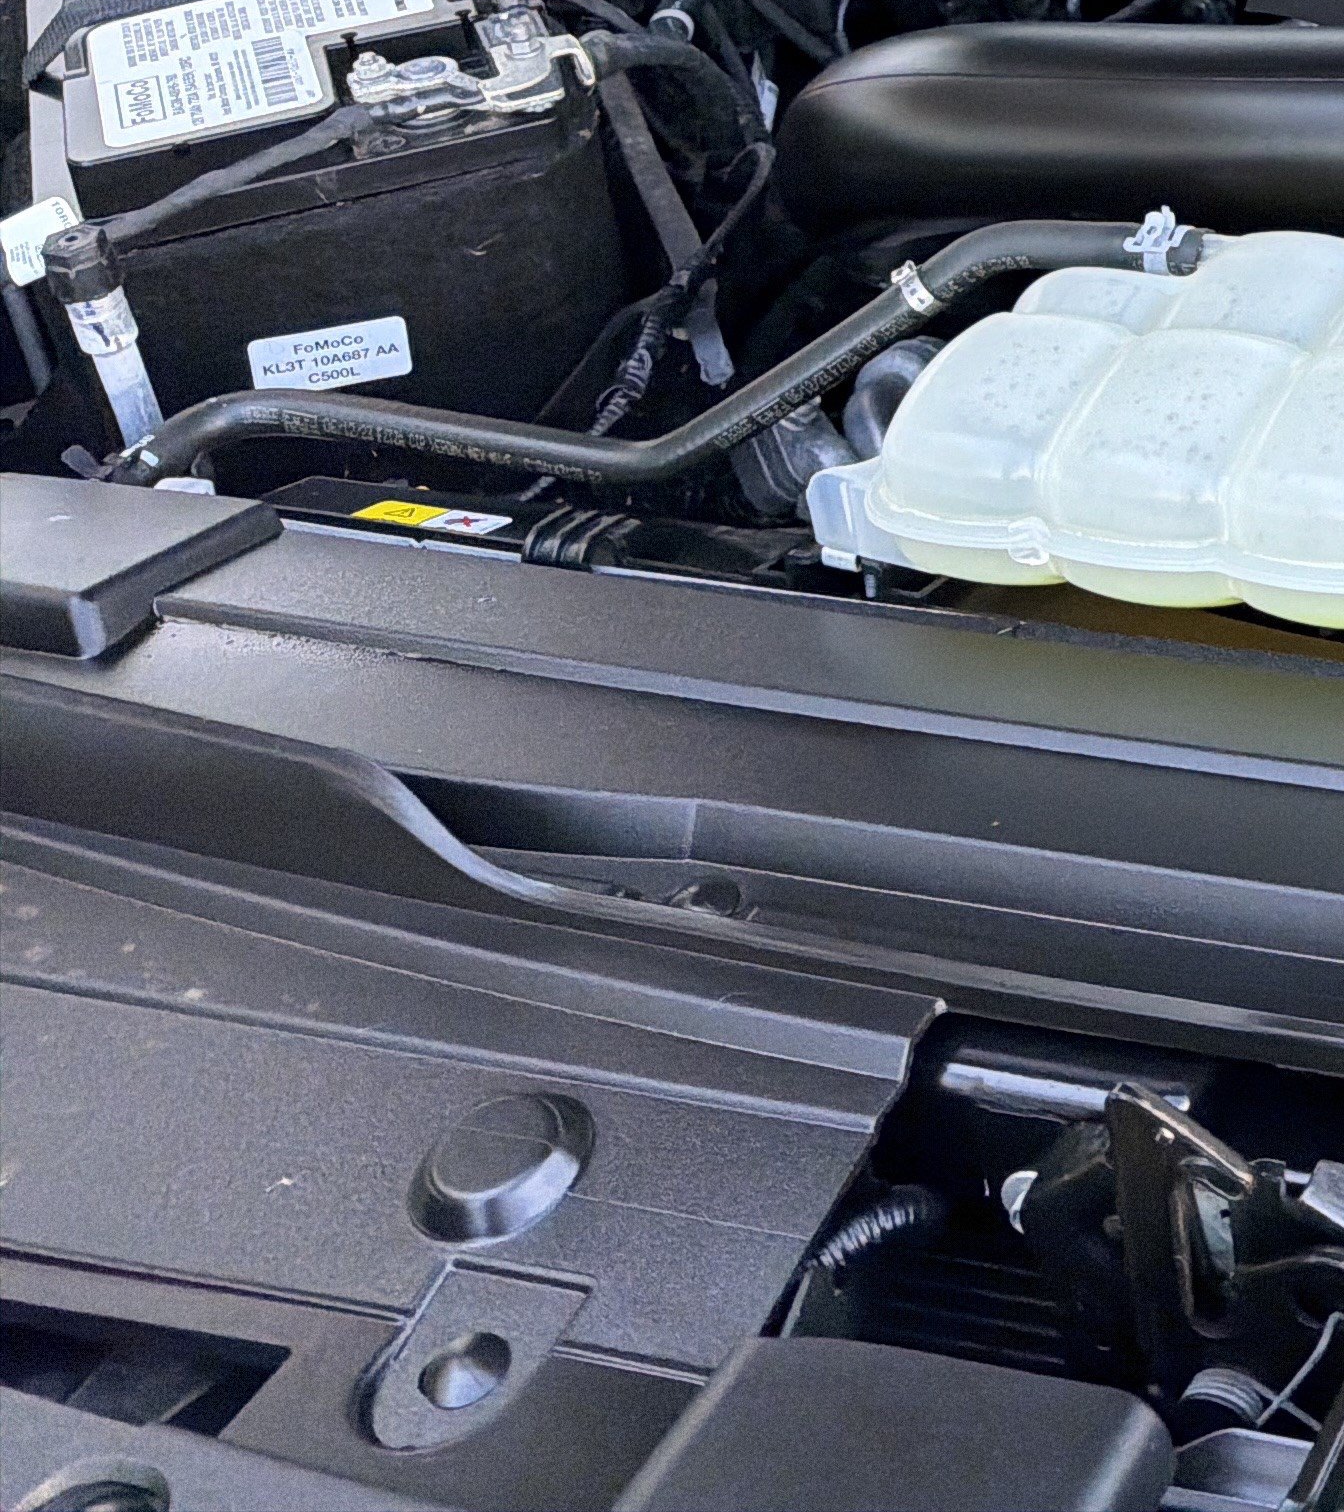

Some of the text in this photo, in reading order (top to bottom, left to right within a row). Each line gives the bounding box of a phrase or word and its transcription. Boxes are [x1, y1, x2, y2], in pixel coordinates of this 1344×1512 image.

[126, 80, 155, 125] FoMoCo
[293, 335, 364, 355] FoMoCo
[262, 342, 400, 376] KL3T 10A687 AA
[308, 366, 361, 384] C500L
